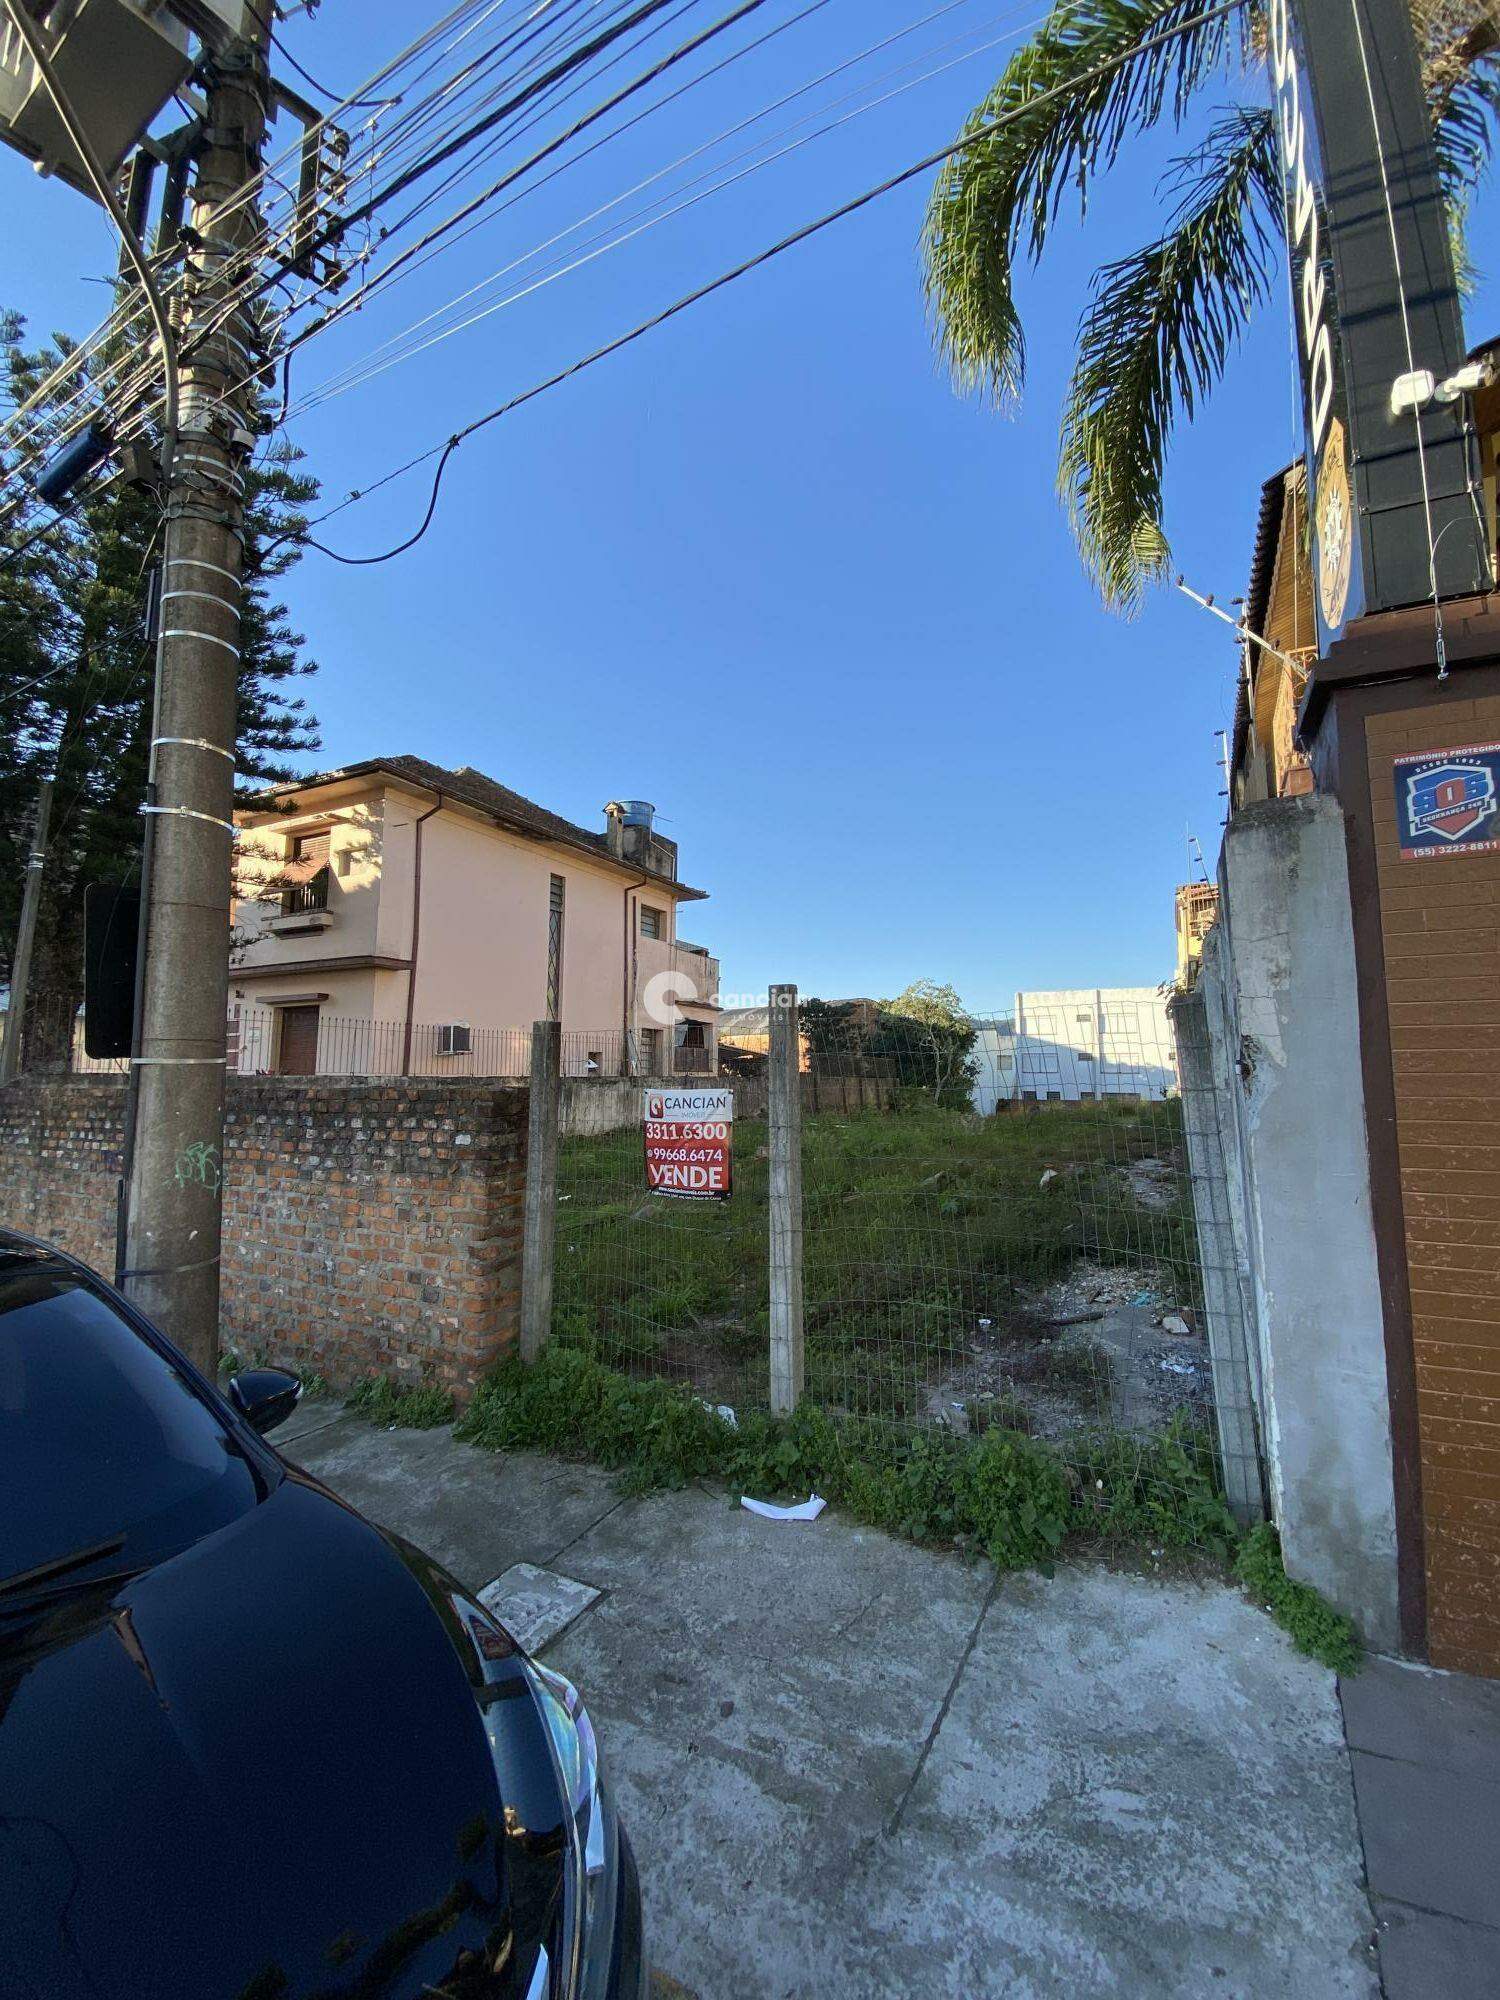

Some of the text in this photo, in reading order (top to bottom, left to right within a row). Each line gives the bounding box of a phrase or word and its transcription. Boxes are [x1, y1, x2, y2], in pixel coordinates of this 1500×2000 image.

[1413, 847, 1436, 858] (55)
[664, 1096, 727, 1109] CANCIAN
[646, 1122, 727, 1140] 3311.6300
[653, 1147, 723, 1162] 99668.6474
[649, 1163, 723, 1188] VENDE
